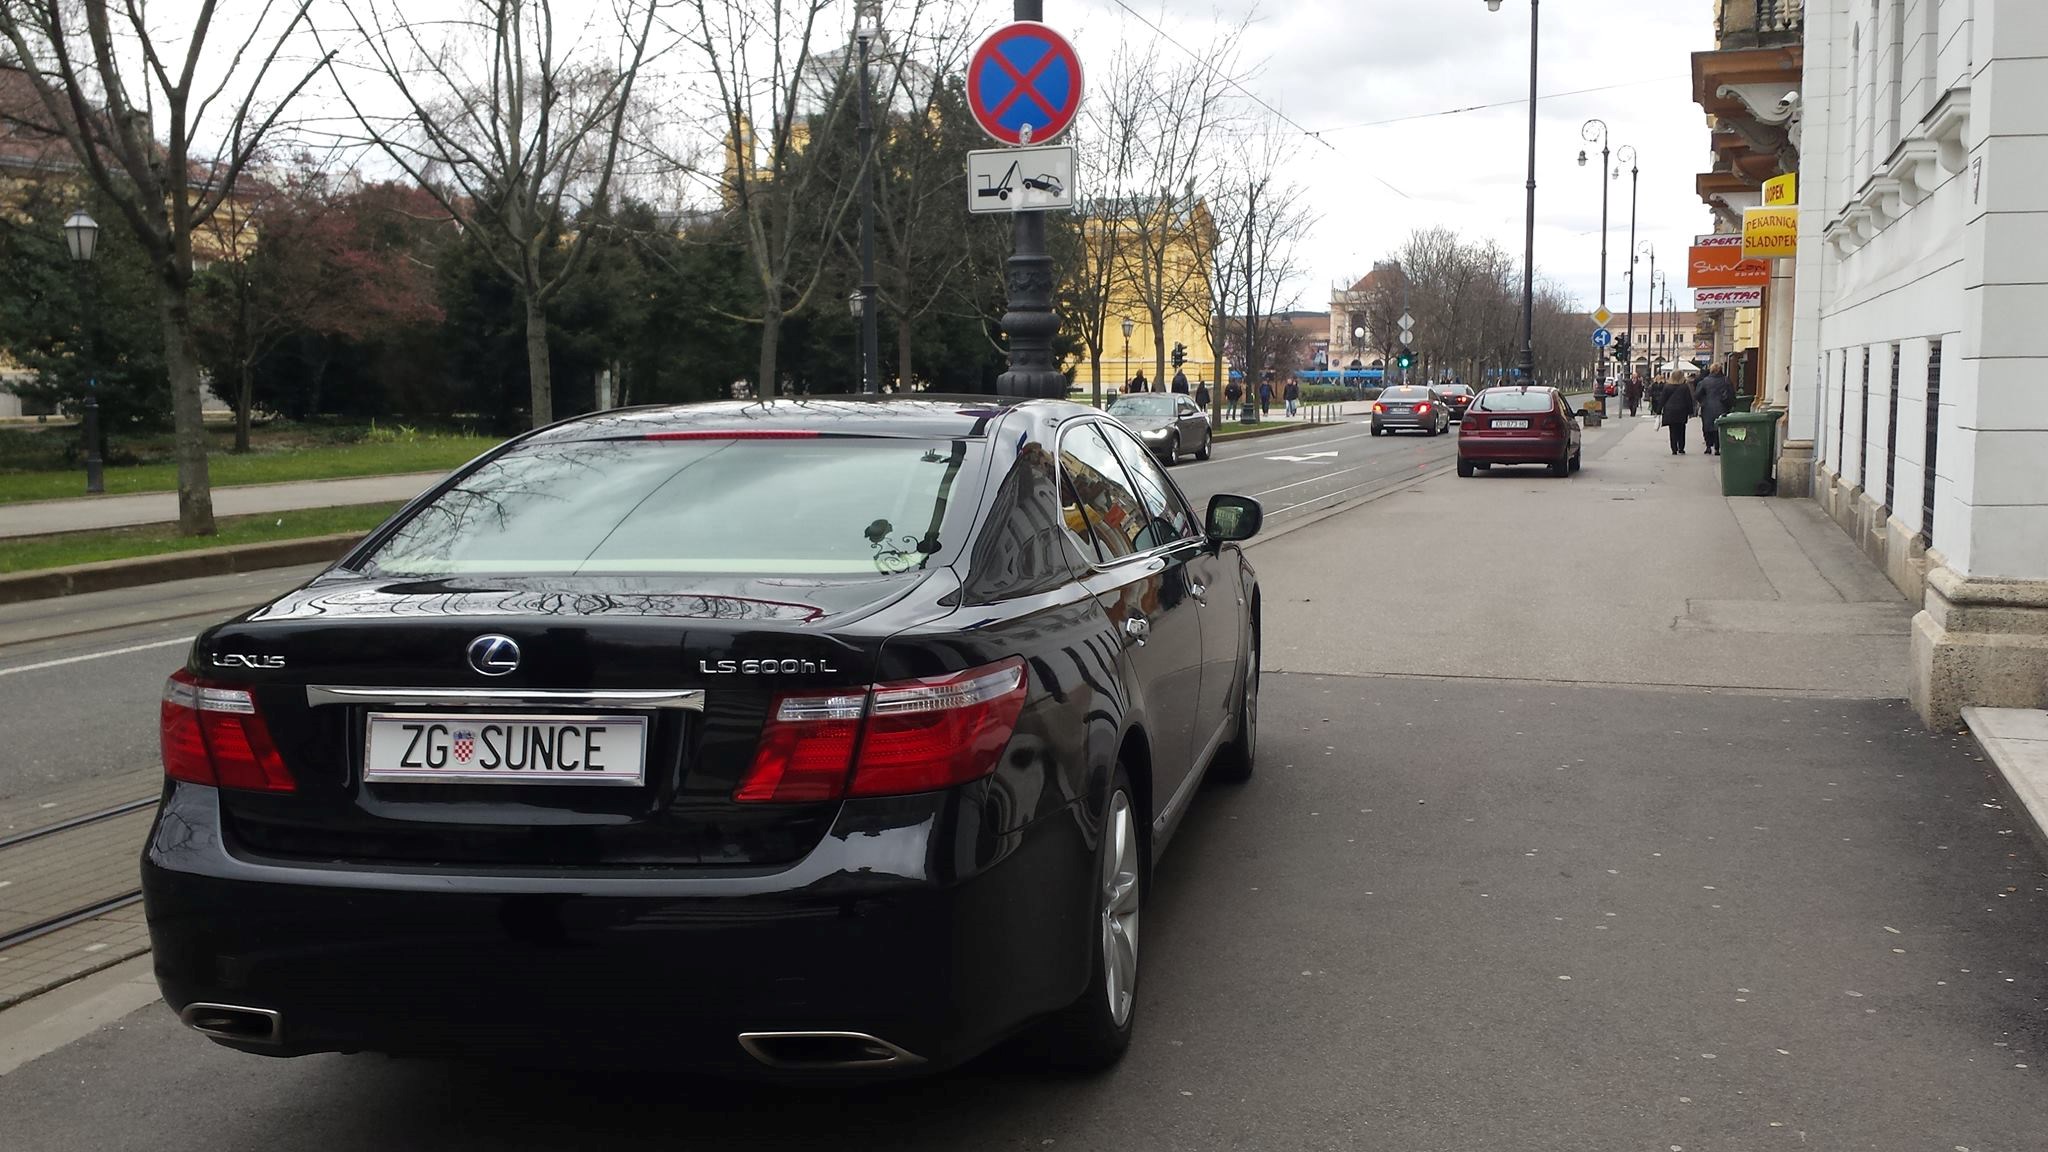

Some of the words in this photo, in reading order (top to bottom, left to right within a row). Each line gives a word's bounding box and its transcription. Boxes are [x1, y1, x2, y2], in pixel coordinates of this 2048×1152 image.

[1746, 215, 1798, 231] PEKARNICA
[1699, 237, 1742, 246] SPEKT
[1745, 234, 1798, 248] SLADOPEK
[1696, 291, 1760, 301] SPEKTAR
[212, 653, 286, 669] LEXUS
[700, 659, 737, 673] LS
[400, 724, 448, 768] ZG
[479, 724, 606, 771] SUNCE
